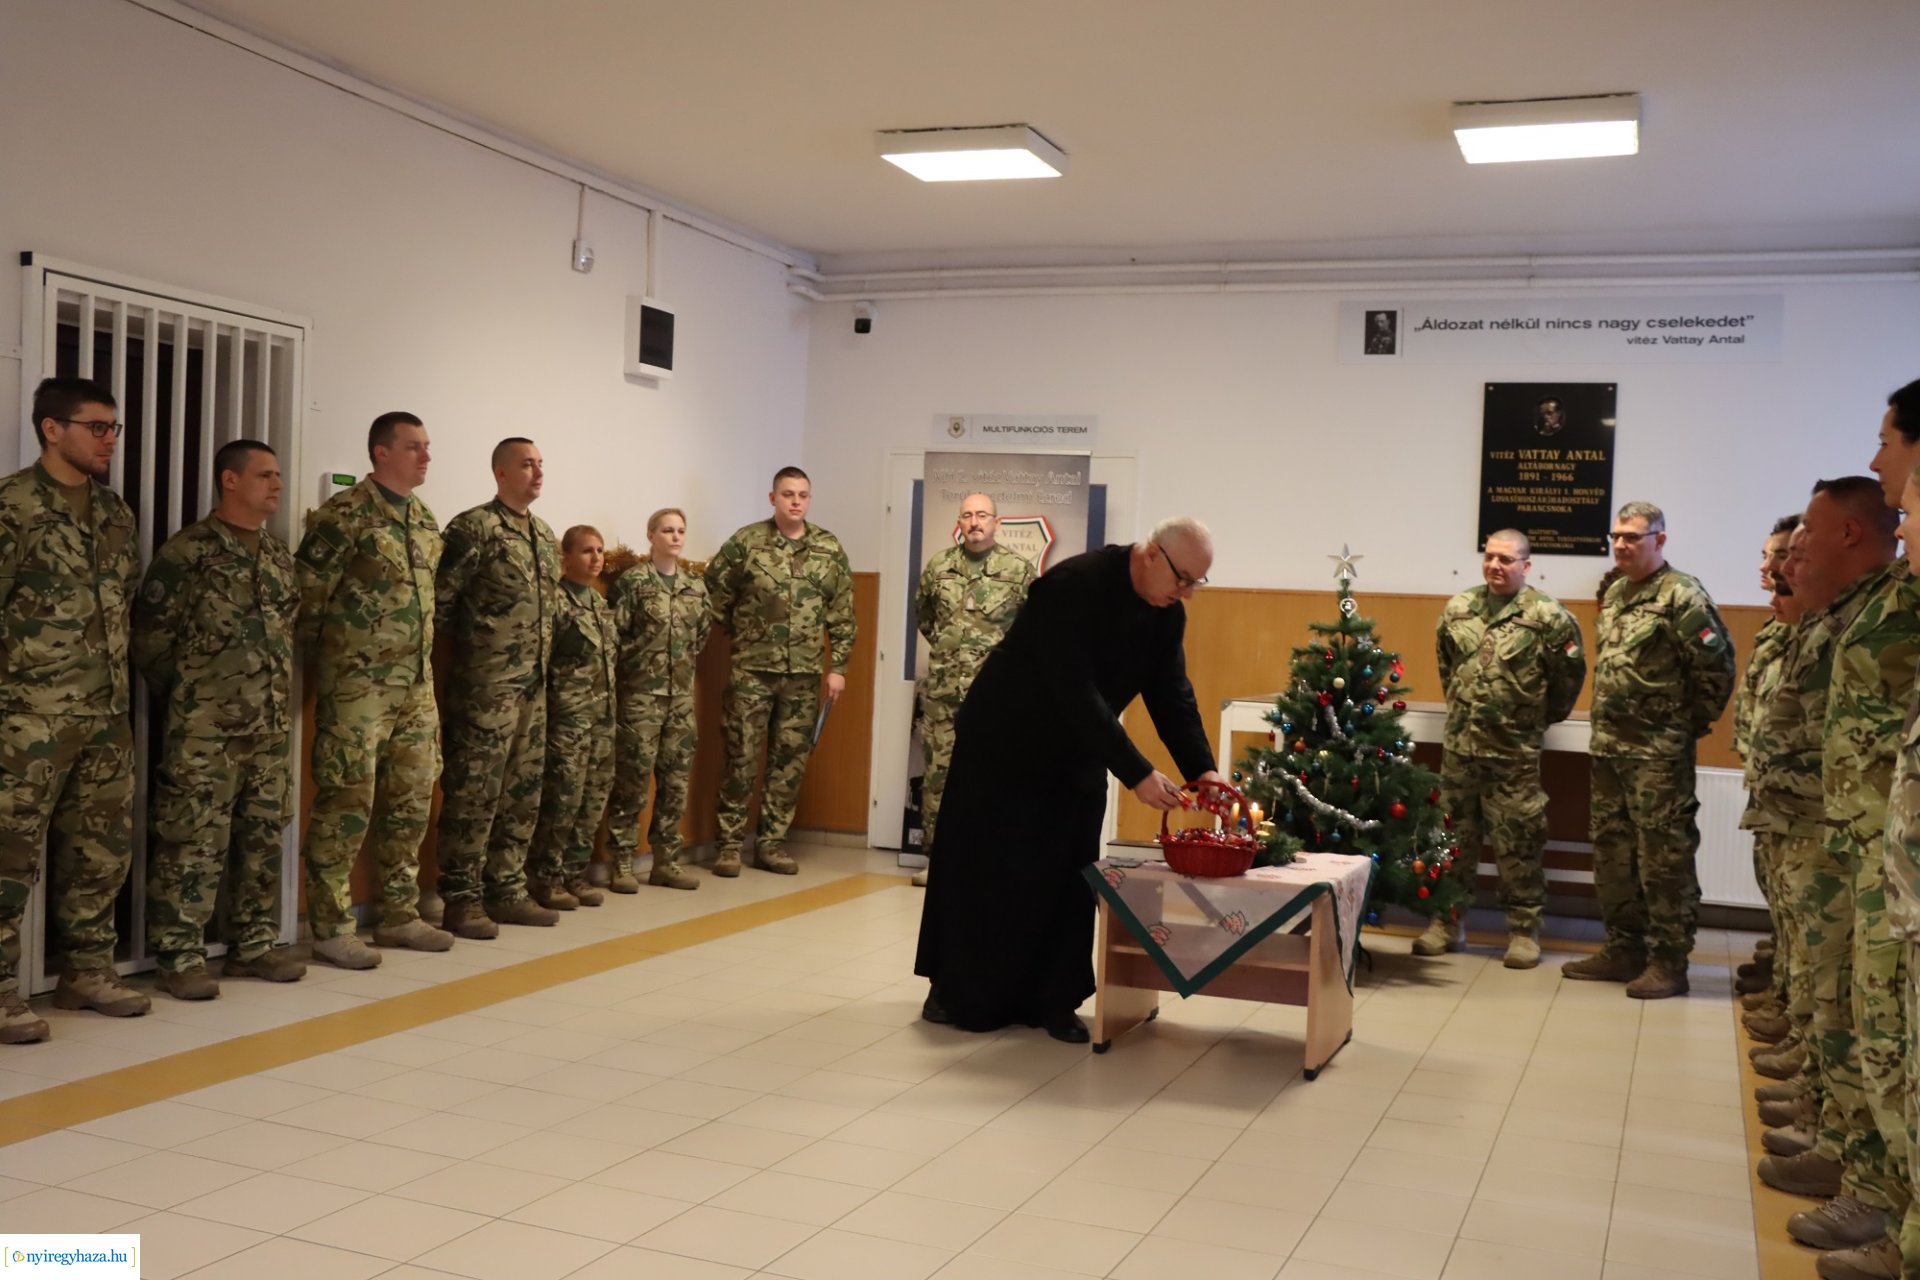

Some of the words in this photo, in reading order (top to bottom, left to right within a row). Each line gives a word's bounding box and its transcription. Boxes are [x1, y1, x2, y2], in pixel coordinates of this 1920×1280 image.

[1489, 316, 1540, 331] nélkül
[1545, 317, 1592, 330] nincs
[1598, 318, 1641, 332] nagy
[1626, 334, 1658, 346] vitéz
[1662, 335, 1704, 347] Vattay
[1709, 334, 1745, 345] Antal
[983, 424, 1054, 434] MULTIFUNKCIÓS
[1057, 426, 1088, 434] TEREM
[1490, 450, 1515, 460] VITÉZ
[1518, 449, 1561, 461] VATTAY
[1566, 450, 1606, 461] ANTAL
[1519, 472, 1540, 481] 1891
[1551, 472, 1574, 482] 1966
[1487, 486, 1493, 494] A
